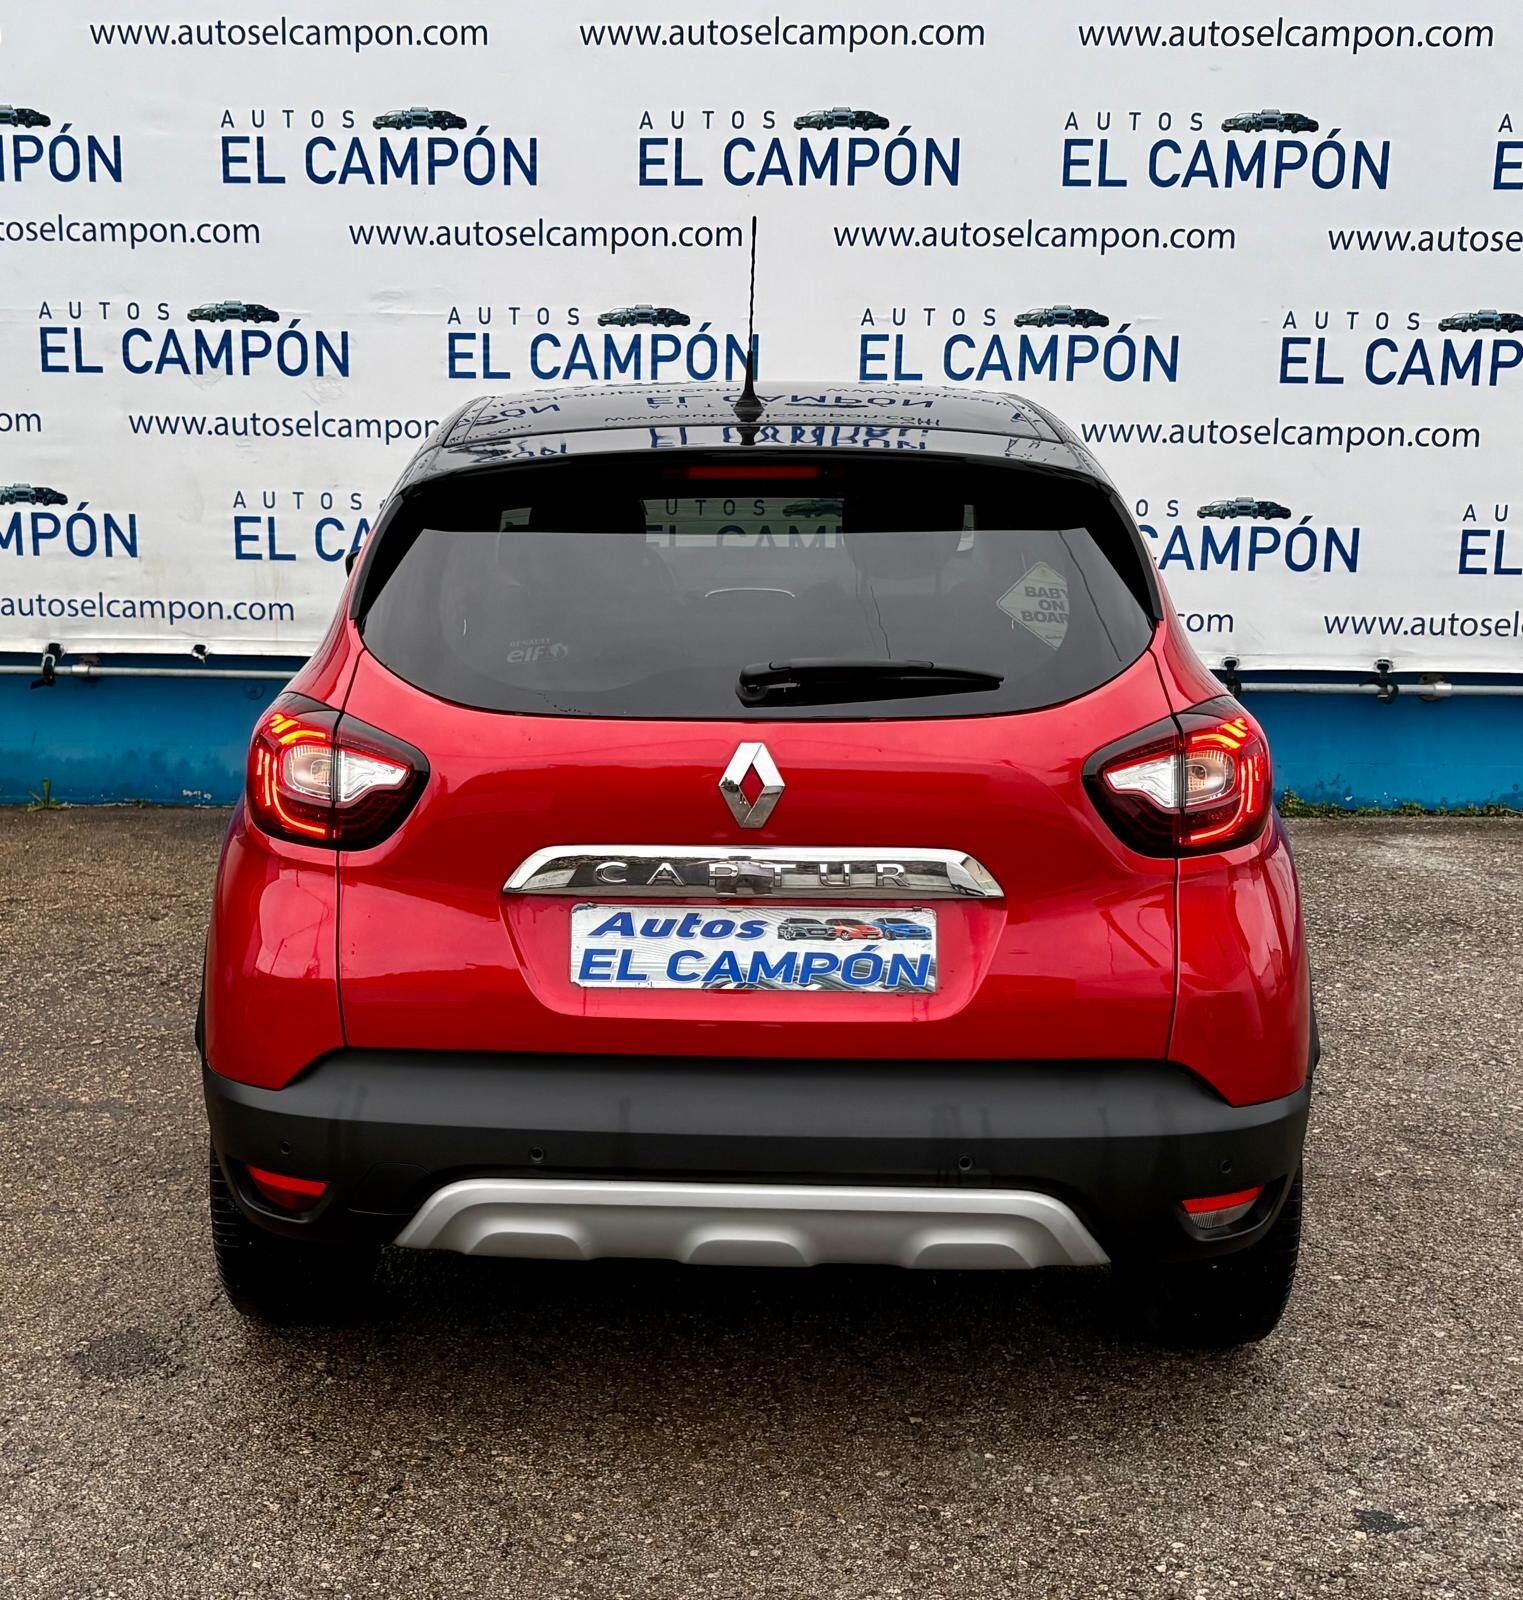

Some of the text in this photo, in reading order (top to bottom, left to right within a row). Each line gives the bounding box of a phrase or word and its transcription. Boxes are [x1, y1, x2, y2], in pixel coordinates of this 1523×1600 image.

[90, 17, 487, 52] www.autoselcampon.com
[580, 16, 984, 52] www.autoselcampon.com
[1079, 17, 1493, 54] www.autoselcampon.com
[221, 110, 354, 128] AUTOS
[640, 111, 775, 129] AUTOS
[1065, 112, 1202, 131] AUTOS
[0, 121, 121, 182] PÓN
[222, 123, 536, 185] EL CAMPÓN
[640, 123, 959, 186] EL CAMPÓN
[1063, 125, 1390, 189] EL CAMPÓN
[349, 219, 742, 254] www.autoselcampon.com
[834, 219, 1234, 255] www.autoselcampon.com
[39, 302, 169, 320] AUTOS
[448, 307, 579, 325] AUTOS
[861, 308, 995, 326] AUTOS
[1283, 311, 1419, 330] AUTOS
[40, 318, 348, 377] EL CAMPÓN
[449, 322, 758, 381] EL CAMPÓN
[860, 323, 1178, 382] EL CAMPÓN
[1280, 337, 1344, 384] EL
[1081, 417, 1480, 453] www.autoselcampon.com
[234, 491, 361, 510] AUTOS
[234, 516, 296, 560] EL
[1459, 530, 1522, 575] EL
[1038, 600, 1065, 611] ON
[595, 861, 910, 887] CAPTUR
[588, 911, 769, 939] Autos
[578, 944, 931, 987] EL CAMPÓN
